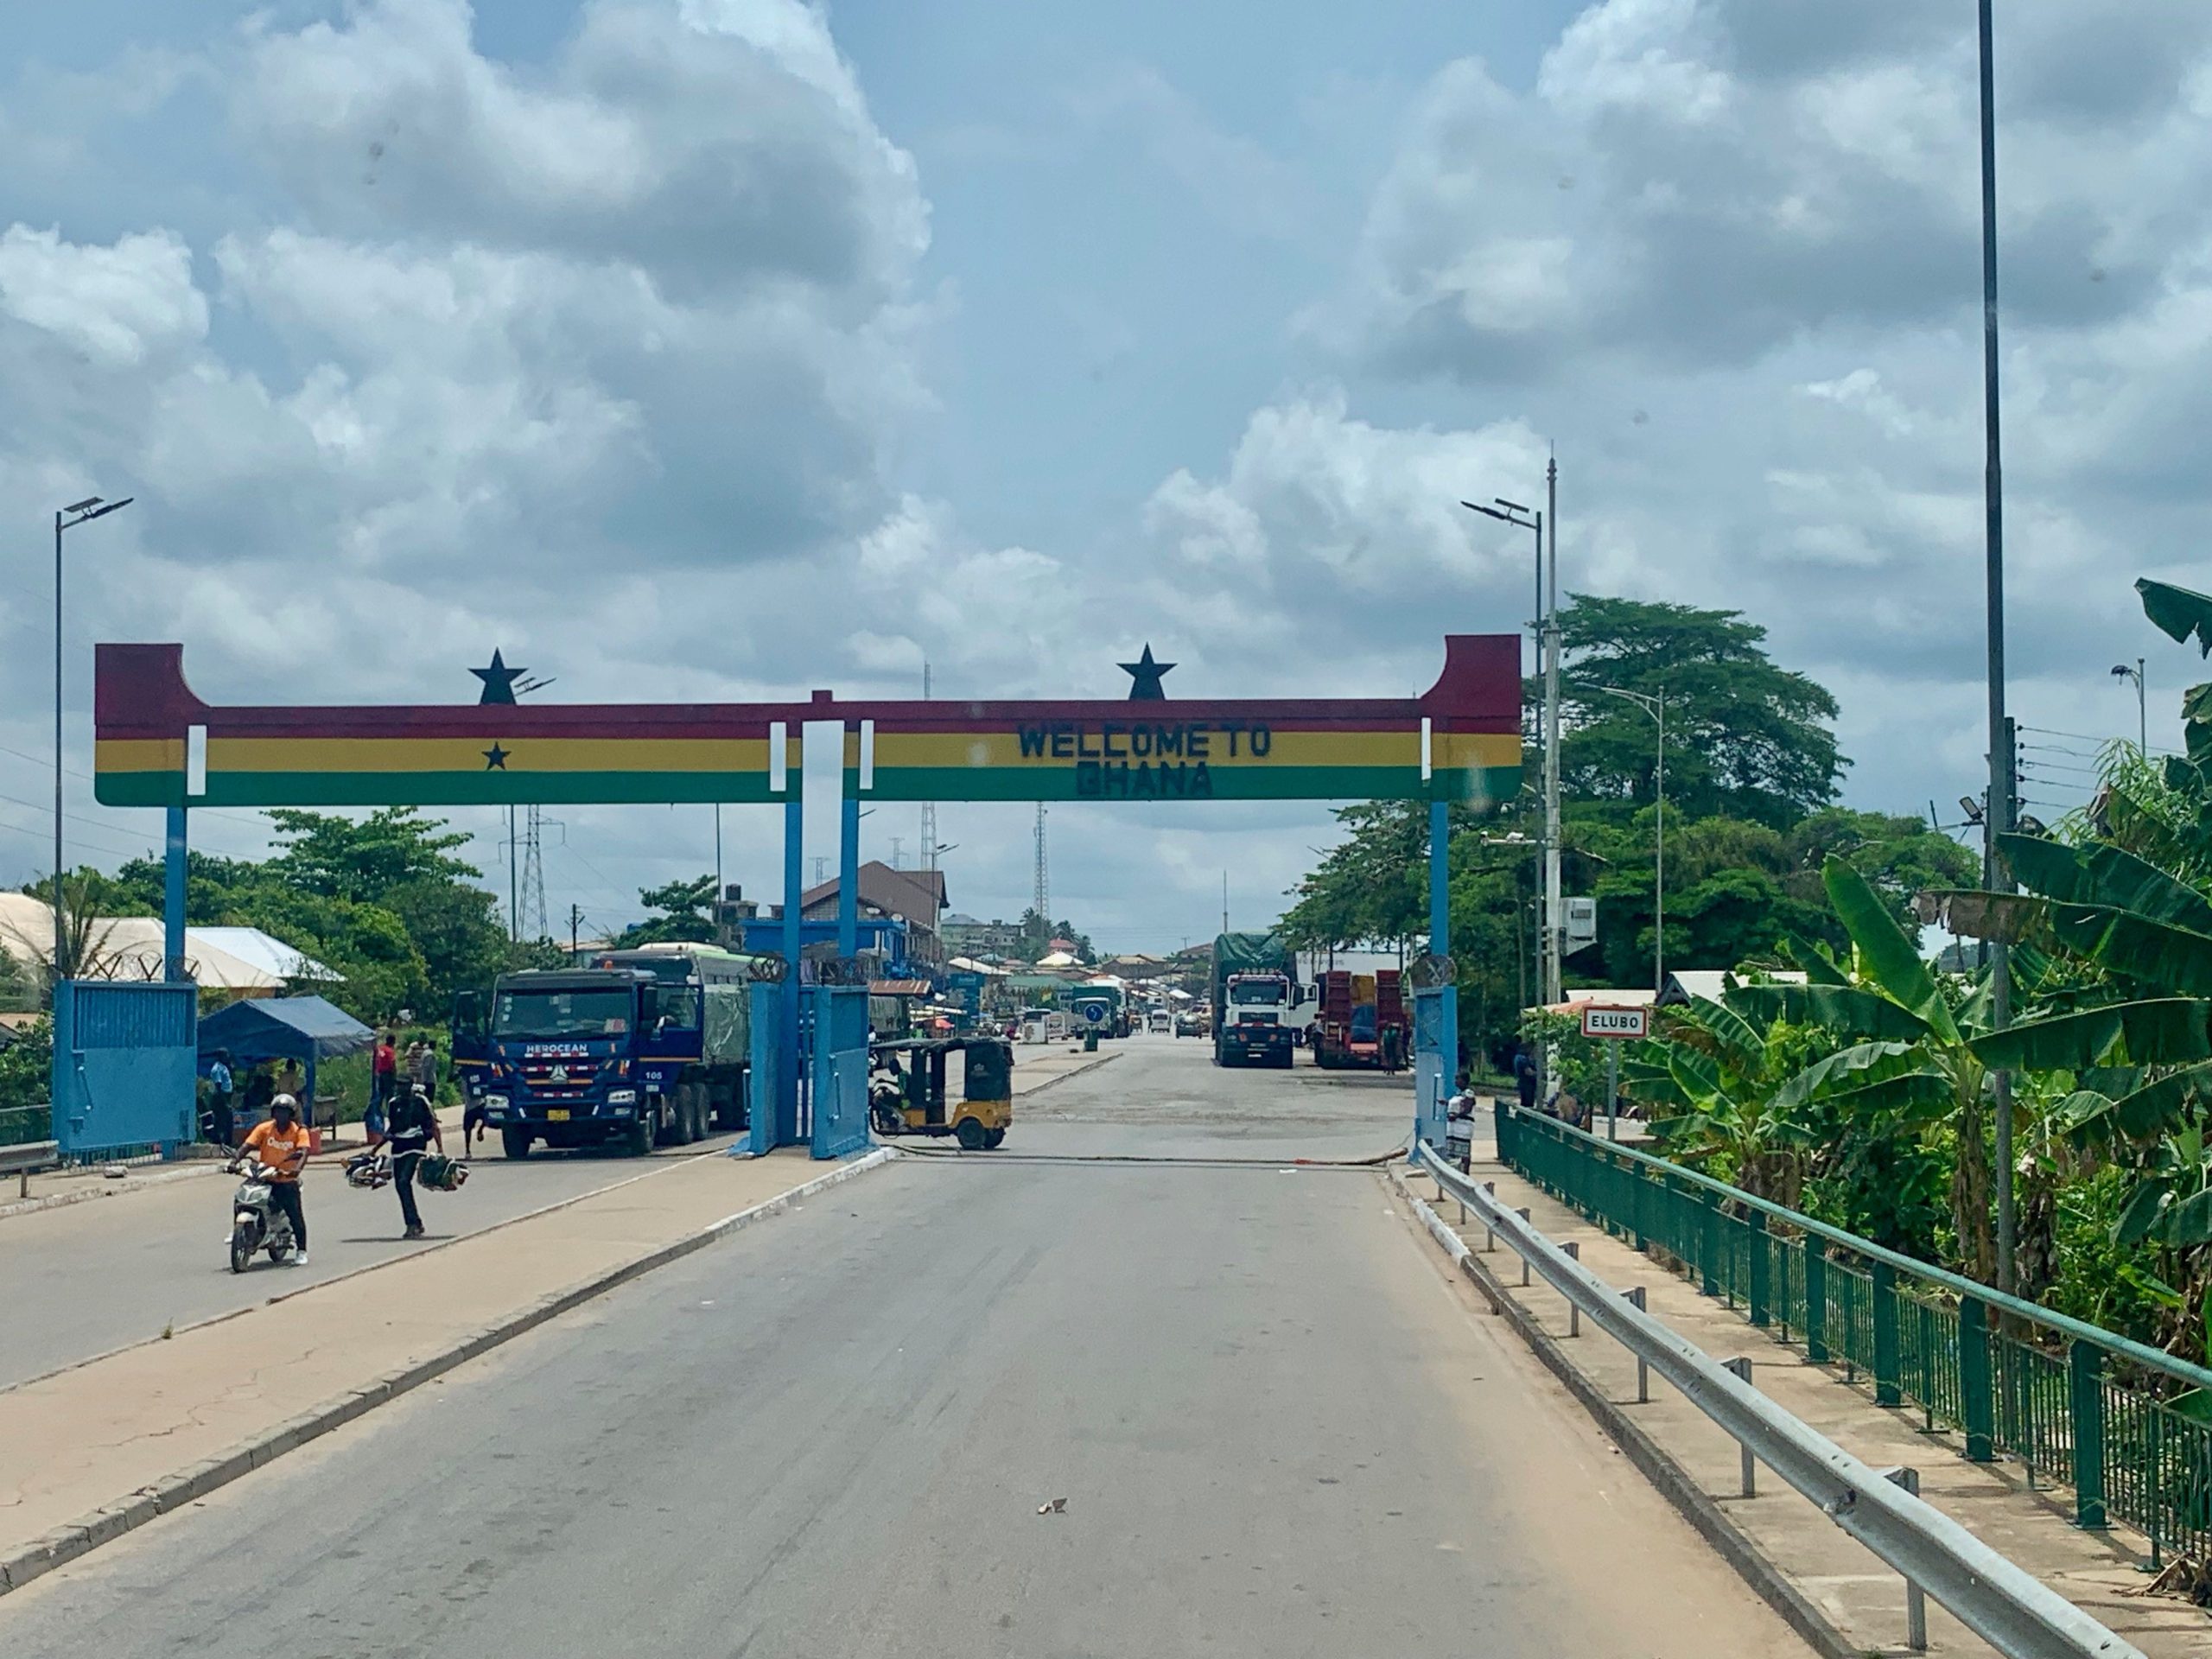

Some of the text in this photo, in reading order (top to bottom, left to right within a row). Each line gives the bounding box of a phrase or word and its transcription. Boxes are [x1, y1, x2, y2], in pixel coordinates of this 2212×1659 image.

[1020, 722, 1271, 758] WELCOME TO
[1076, 761, 1213, 795] GHANA
[1592, 1015, 1638, 1028] ELUBO
[526, 1044, 588, 1053] HEROCEAN
[645, 1071, 663, 1080] 105
